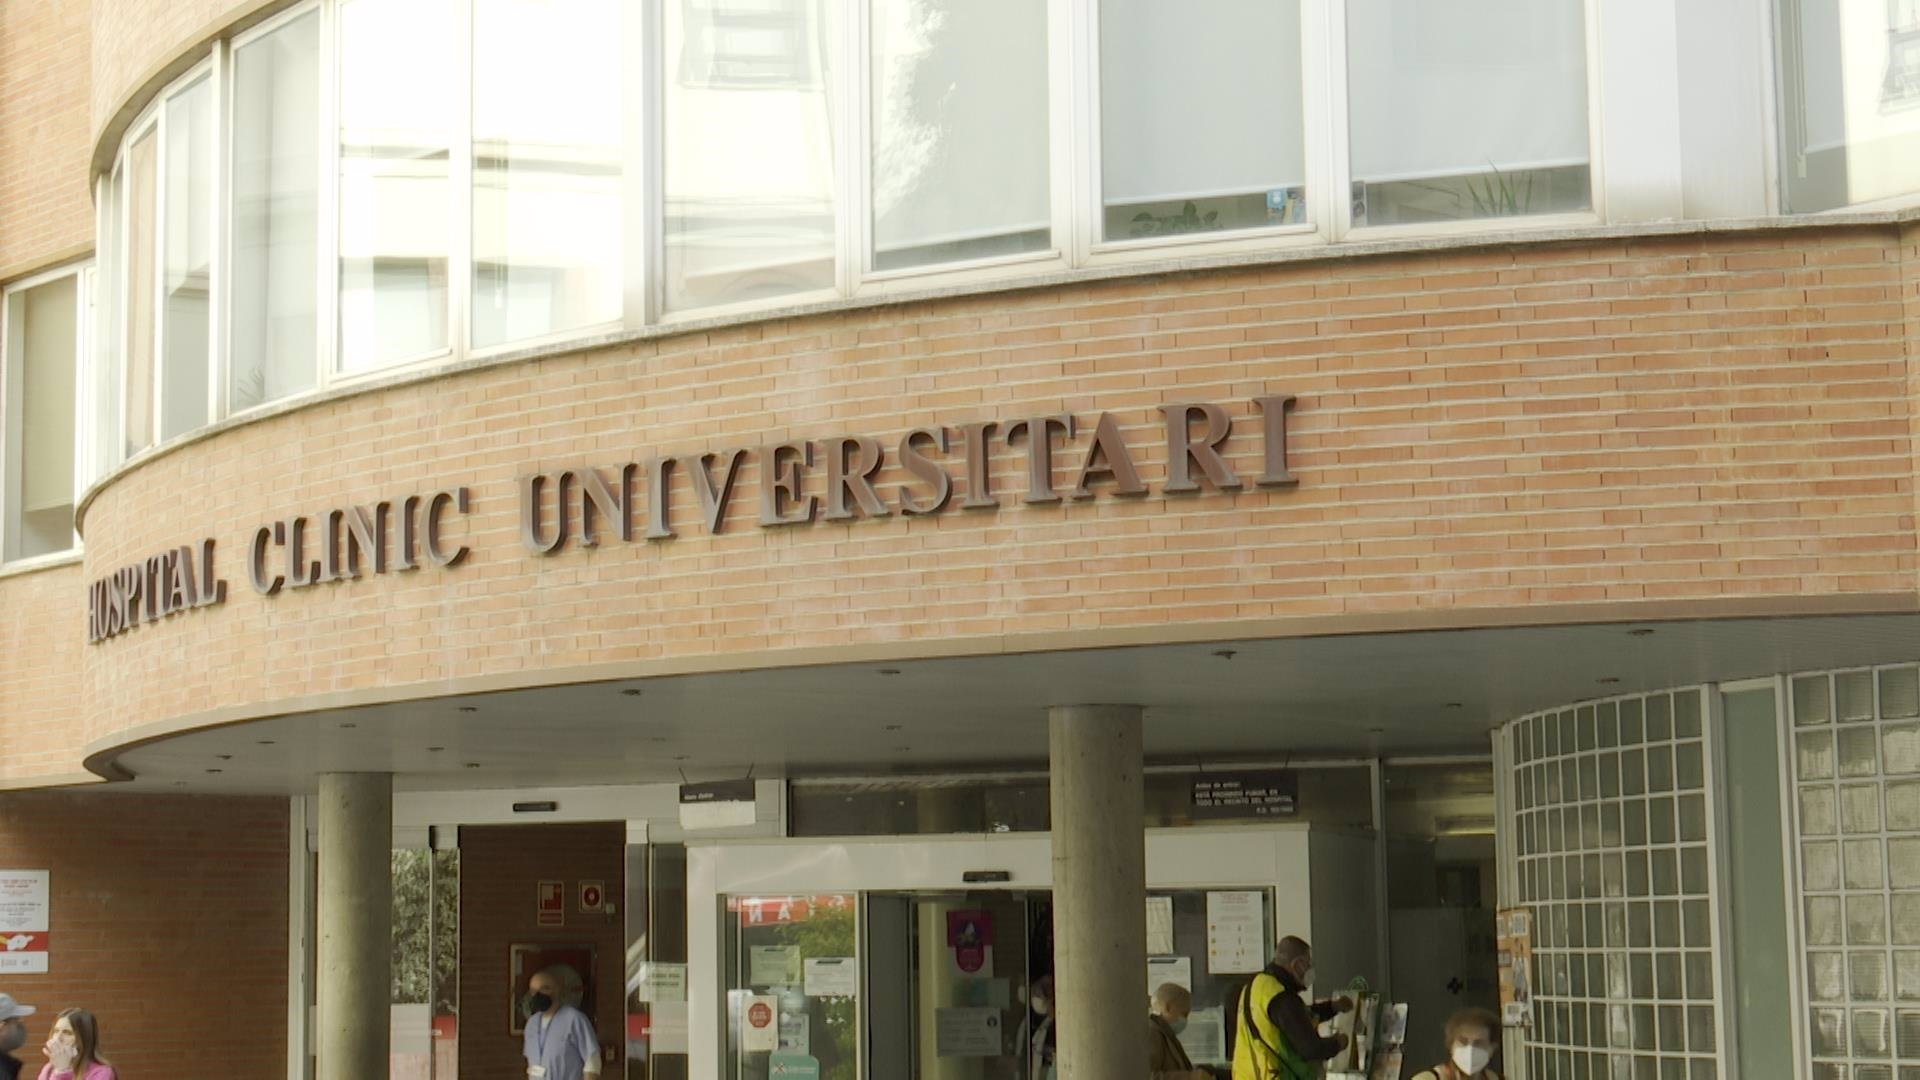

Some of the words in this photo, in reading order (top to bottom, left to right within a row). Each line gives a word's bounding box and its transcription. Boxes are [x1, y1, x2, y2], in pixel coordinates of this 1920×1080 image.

[88, 537, 229, 645] HOSPITAL
[247, 487, 471, 596] CLINIC
[516, 394, 1300, 555] UNIVERSITARI
